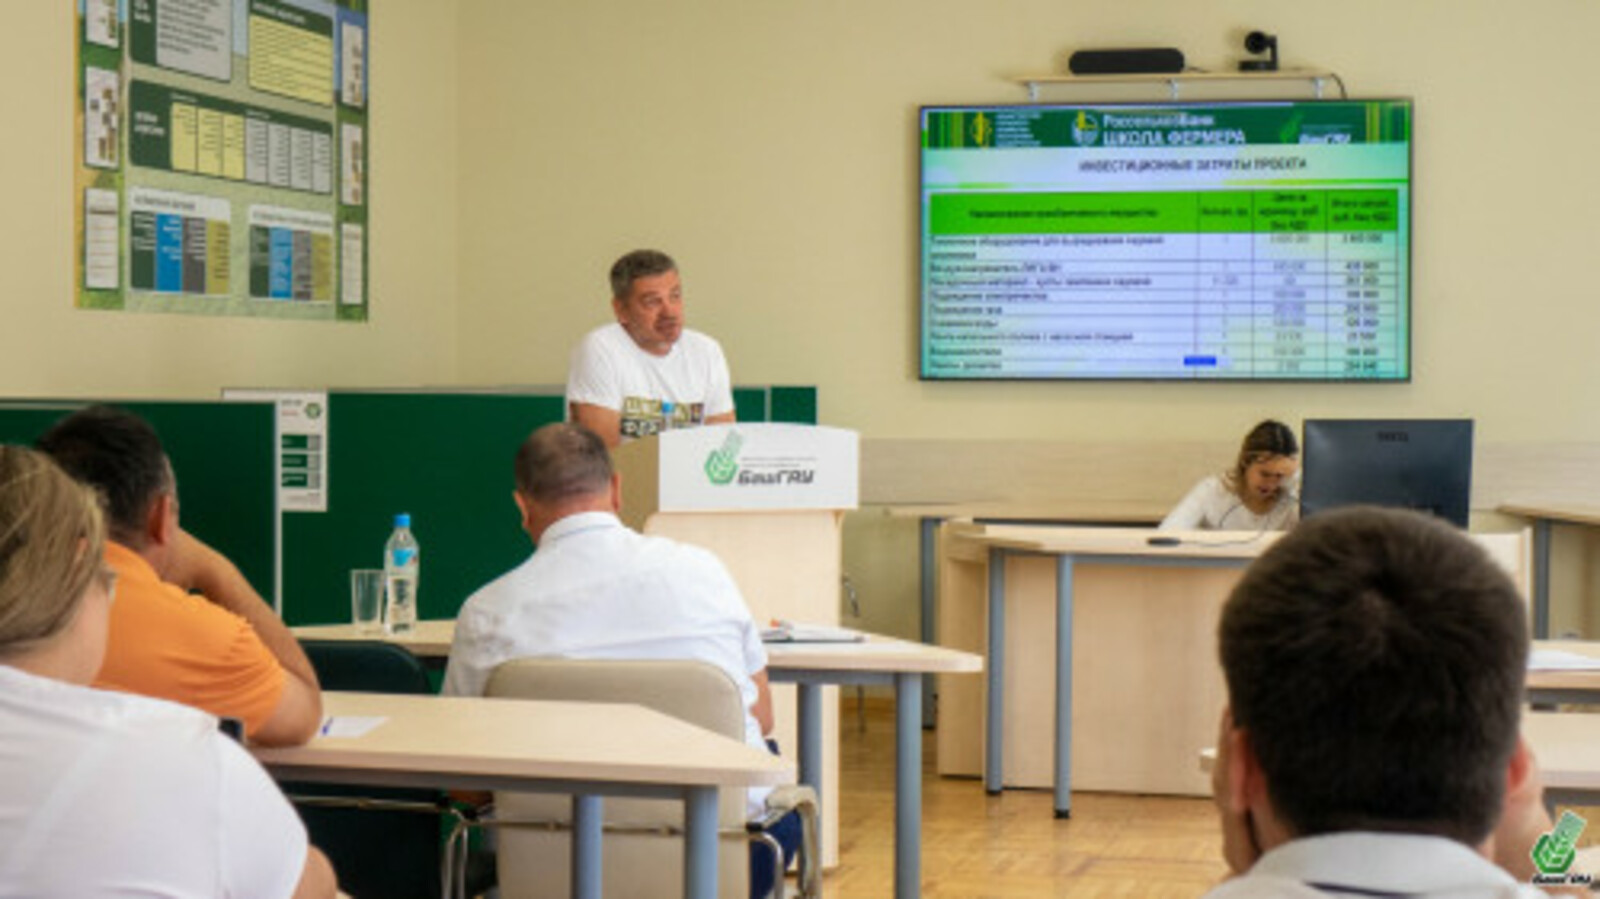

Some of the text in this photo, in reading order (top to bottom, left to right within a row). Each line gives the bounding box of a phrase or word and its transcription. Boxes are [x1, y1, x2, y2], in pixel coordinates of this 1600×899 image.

[1103, 129, 1246, 145] ШКОЛА ФЕРМЕРА
[1079, 157, 1307, 173] ИНВЕСТИЦИОННЫЕ ЗАТРАТЫ ПРОЕКТА
[738, 469, 815, 485] БашГАУ
